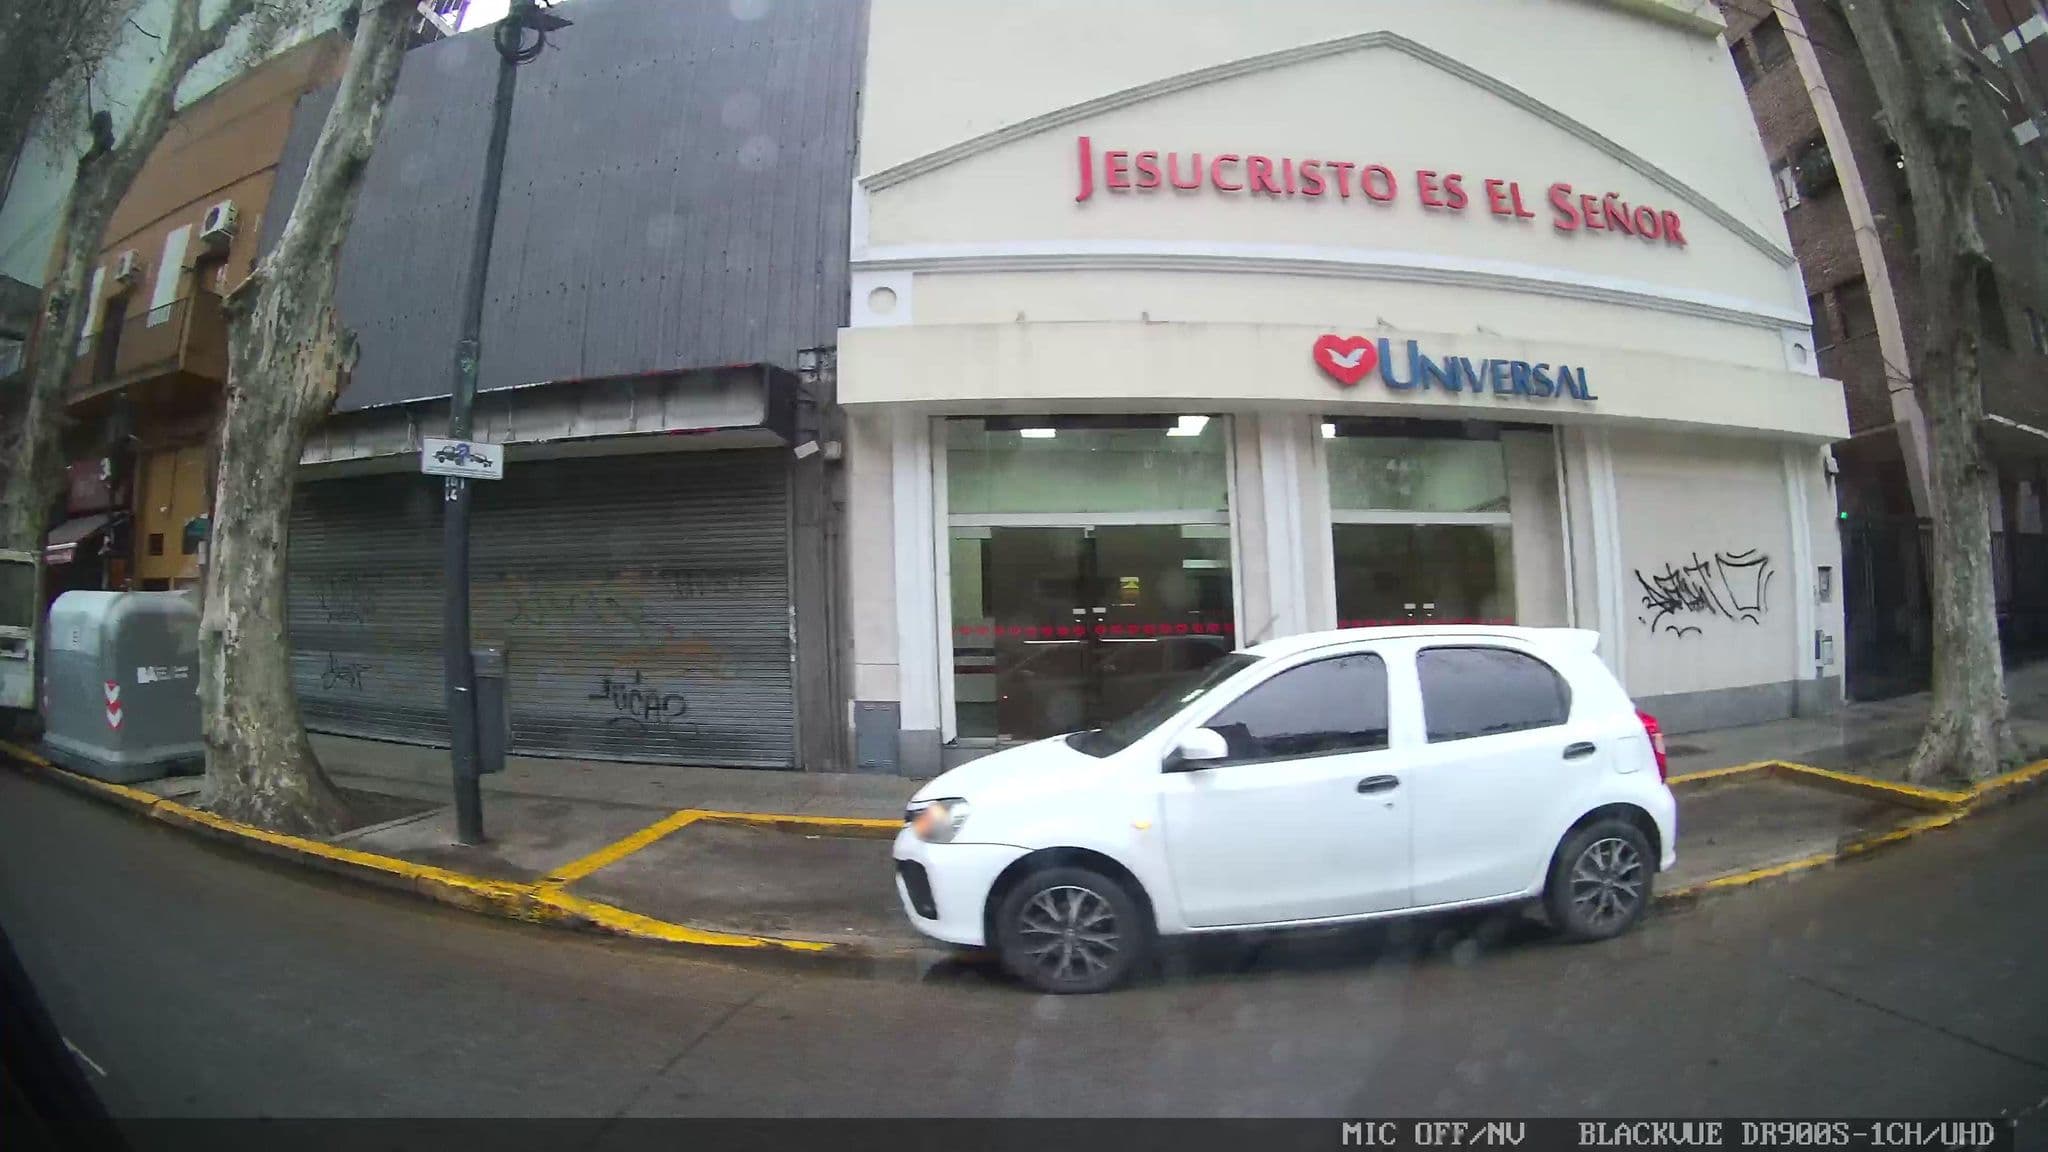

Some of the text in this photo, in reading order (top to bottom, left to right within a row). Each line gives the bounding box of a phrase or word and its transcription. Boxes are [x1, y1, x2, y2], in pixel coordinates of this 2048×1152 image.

[1076, 136, 1688, 247] JESUCRISTO ES EL SEÑOR
[1378, 337, 1599, 402] UNIVERSAL
